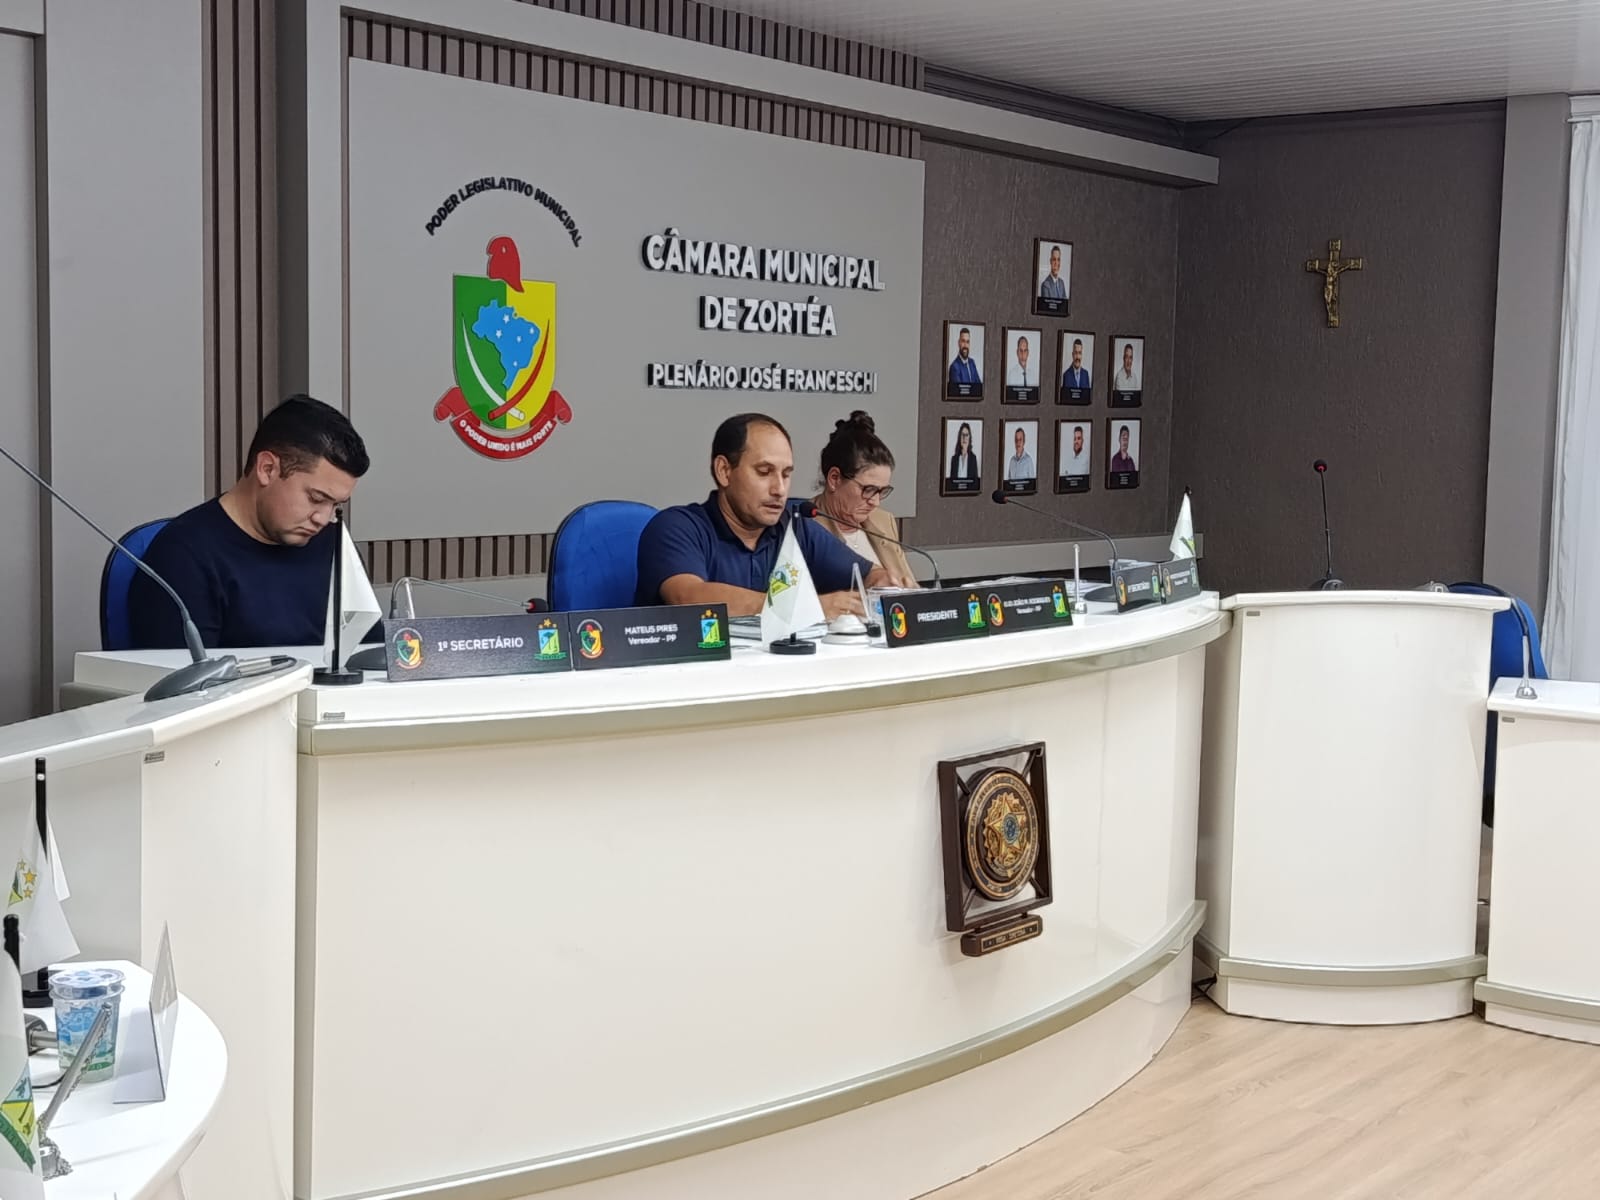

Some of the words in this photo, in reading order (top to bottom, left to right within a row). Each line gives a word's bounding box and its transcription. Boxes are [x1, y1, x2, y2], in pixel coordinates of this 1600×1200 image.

[425, 194, 460, 236] PODER
[458, 176, 533, 202] LEGISLATIVO
[534, 188, 583, 248] MUNICIPAL
[643, 228, 758, 281] CÂMARA
[760, 248, 886, 291] MUNICIPAL
[700, 295, 738, 331] DE
[739, 295, 837, 337] ZORTÉA
[648, 360, 738, 391] PLENÁRIO
[739, 362, 782, 391] JOSÉ
[783, 368, 878, 393] FRANCESCHI
[459, 419, 467, 428] O
[916, 609, 959, 623] PRESIDENTE
[624, 624, 656, 636] MATEUS
[656, 623, 679, 633] PIRES
[450, 635, 524, 652] SECRETÁRIO
